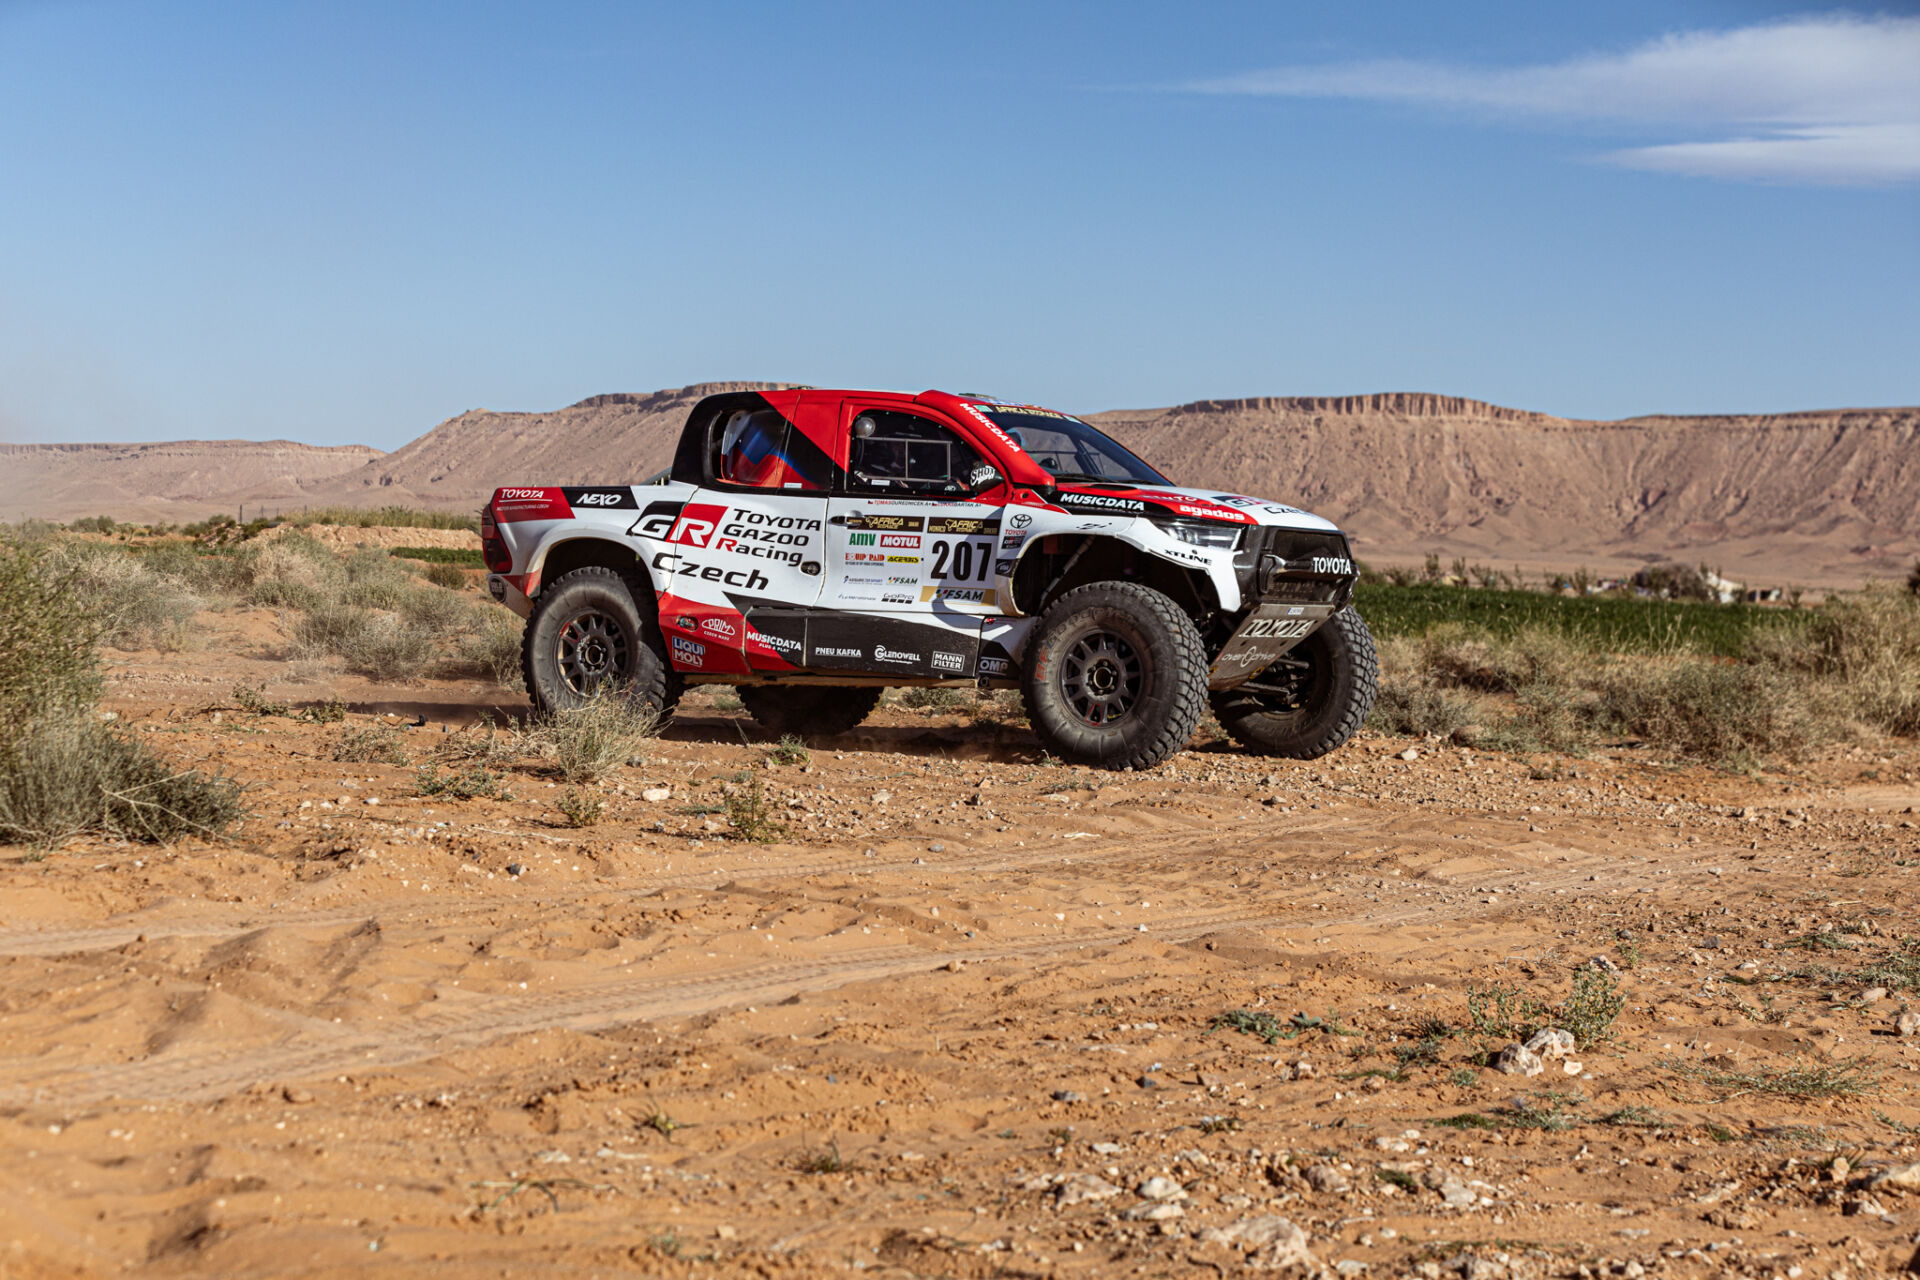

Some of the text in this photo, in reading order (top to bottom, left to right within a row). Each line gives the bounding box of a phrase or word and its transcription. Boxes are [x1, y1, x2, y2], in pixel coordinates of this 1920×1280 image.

[960, 403, 1020, 453] MUSICDATA
[501, 489, 544, 499] TOYOTA
[576, 493, 622, 506] NEXO
[1060, 493, 1145, 511] MUSICDATA
[733, 508, 821, 531] TOYOTA
[872, 516, 904, 526] AFRICA
[1179, 505, 1245, 521] agados
[631, 514, 714, 546] GR
[950, 520, 983, 529] AFRICA
[723, 523, 810, 547] GAZOO
[849, 532, 876, 546] AMV
[882, 535, 919, 547] MOTUL
[715, 538, 803, 567] Racing
[931, 540, 992, 581] 207
[652, 552, 769, 590] Czech
[1312, 557, 1352, 575] TOYOTA
[894, 576, 918, 585] FSAM
[945, 590, 985, 601] FSAM
[1238, 619, 1316, 638] TOYOTA
[673, 637, 704, 656] LIQUI
[746, 631, 802, 651] MUSICDATA
[673, 649, 703, 666] MOLY
[815, 647, 862, 657] PNEU KAFKA
[935, 653, 963, 663] MANN
[934, 660, 962, 669] FILTER
[980, 658, 1008, 672] OMP
